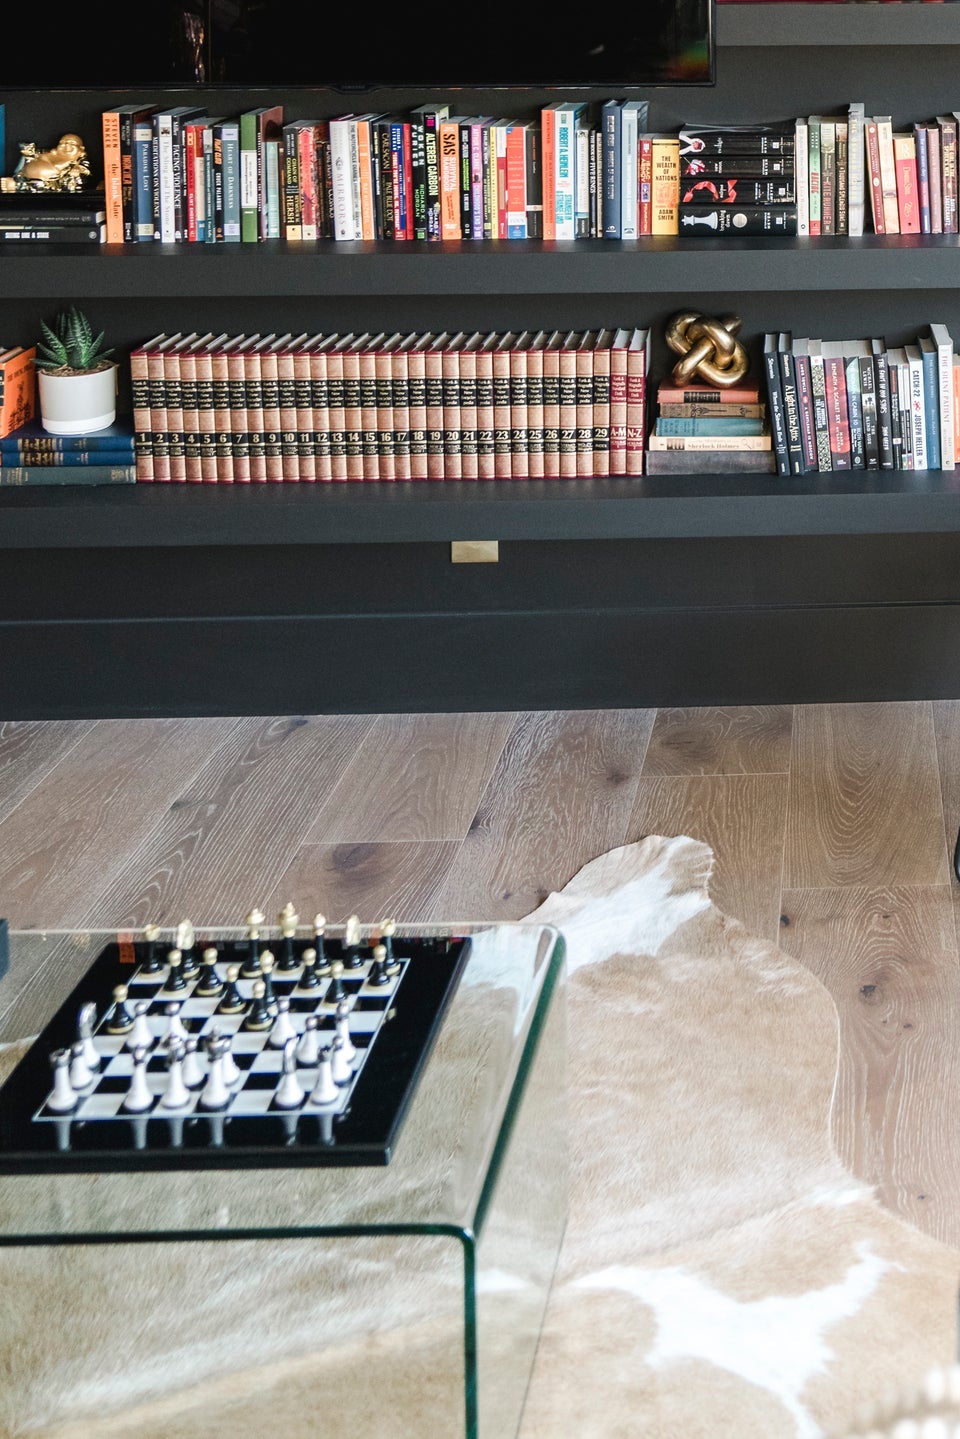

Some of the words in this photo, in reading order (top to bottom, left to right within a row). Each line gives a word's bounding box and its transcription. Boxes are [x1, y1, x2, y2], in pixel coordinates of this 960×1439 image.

[560, 127, 568, 147] ROBERT
[425, 133, 436, 164] ALTERED
[443, 133, 456, 156] SAS
[172, 144, 180, 171] FACING
[111, 164, 119, 176] the
[227, 166, 233, 174] OF
[153, 178, 159, 187] ON
[428, 165, 438, 196] CARBON
[112, 177, 120, 199] blank
[173, 172, 181, 209] VIOLENCE
[227, 177, 235, 209] DARKNESS
[336, 173, 346, 226] MIRRORS
[912, 370, 920, 397] CATCH-22
[785, 392, 795, 407] Light
[788, 415, 797, 426] the
[914, 414, 922, 436] JOSEPH
[157, 434, 163, 442] 2
[172, 434, 178, 442] 3
[220, 434, 227, 442] 6
[253, 434, 259, 442] 8
[269, 434, 276, 442] 9
[283, 433, 294, 442] 10
[300, 433, 309, 442] 11
[316, 434, 328, 442] 12
[332, 433, 342, 442] 13
[348, 433, 359, 441] 14
[366, 433, 375, 441] 15
[381, 433, 391, 441] 16
[397, 433, 406, 441] 17
[413, 431, 424, 440] 18
[430, 432, 440, 440] 19
[447, 432, 458, 440] 20
[464, 432, 474, 440] 21
[496, 431, 508, 439] 23
[513, 430, 526, 439] 24
[529, 430, 541, 439] 25
[546, 430, 557, 438] 26
[562, 431, 574, 439] 27
[579, 430, 591, 438] 28
[595, 429, 607, 438] 29
[790, 426, 799, 441] Attic
[188, 435, 194, 443] 4
[204, 435, 210, 443] 5
[236, 435, 242, 443] 7
